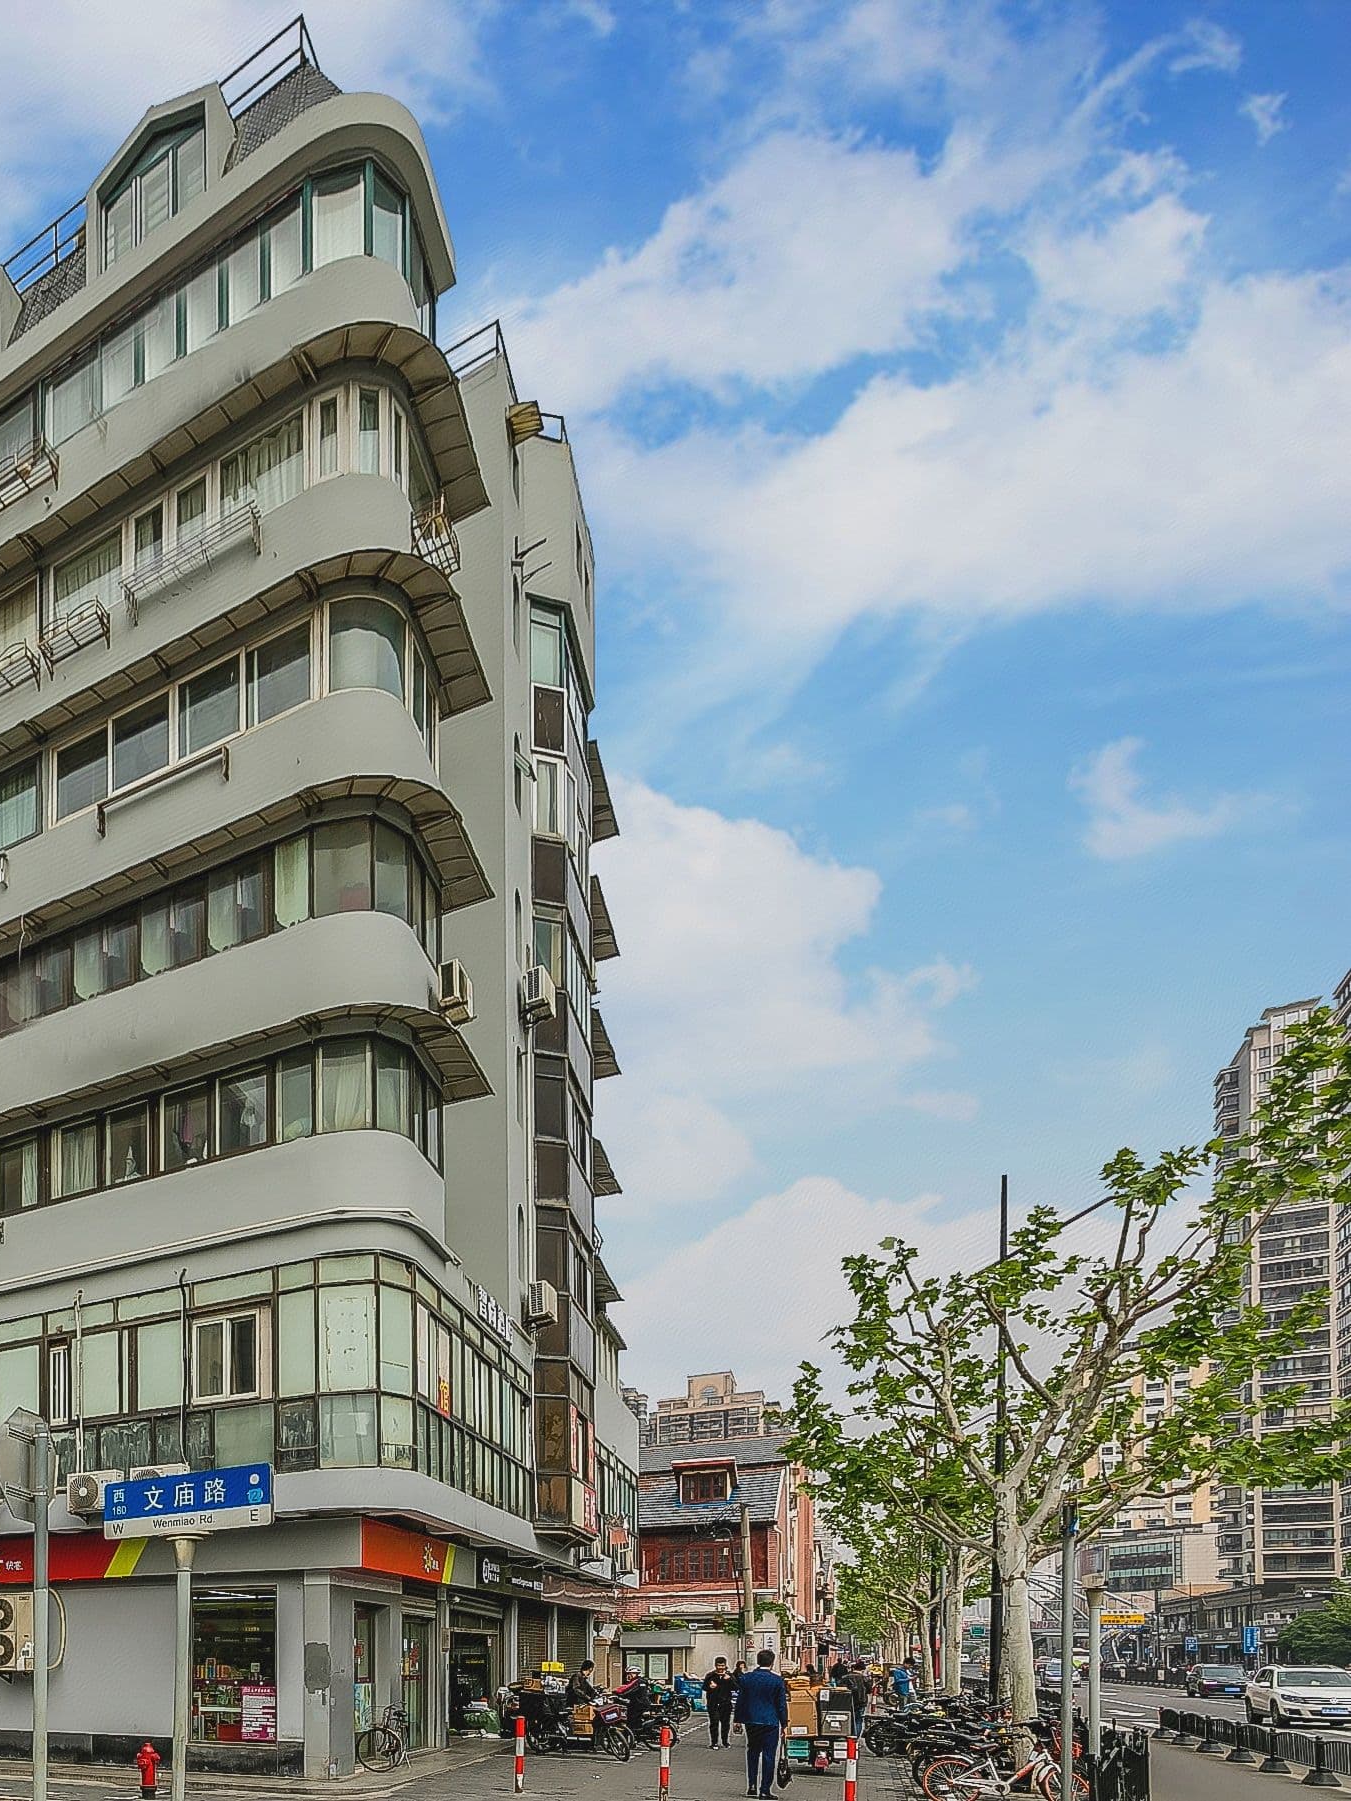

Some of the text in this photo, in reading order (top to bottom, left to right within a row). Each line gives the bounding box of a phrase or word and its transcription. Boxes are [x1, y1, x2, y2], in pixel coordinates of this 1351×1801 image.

[112, 1488, 125, 1503] 西
[143, 1477, 227, 1511] 文庙路
[152, 1514, 216, 1529] Wenmiao Rd.
[250, 1509, 259, 1522] E
[112, 1523, 124, 1535] W
